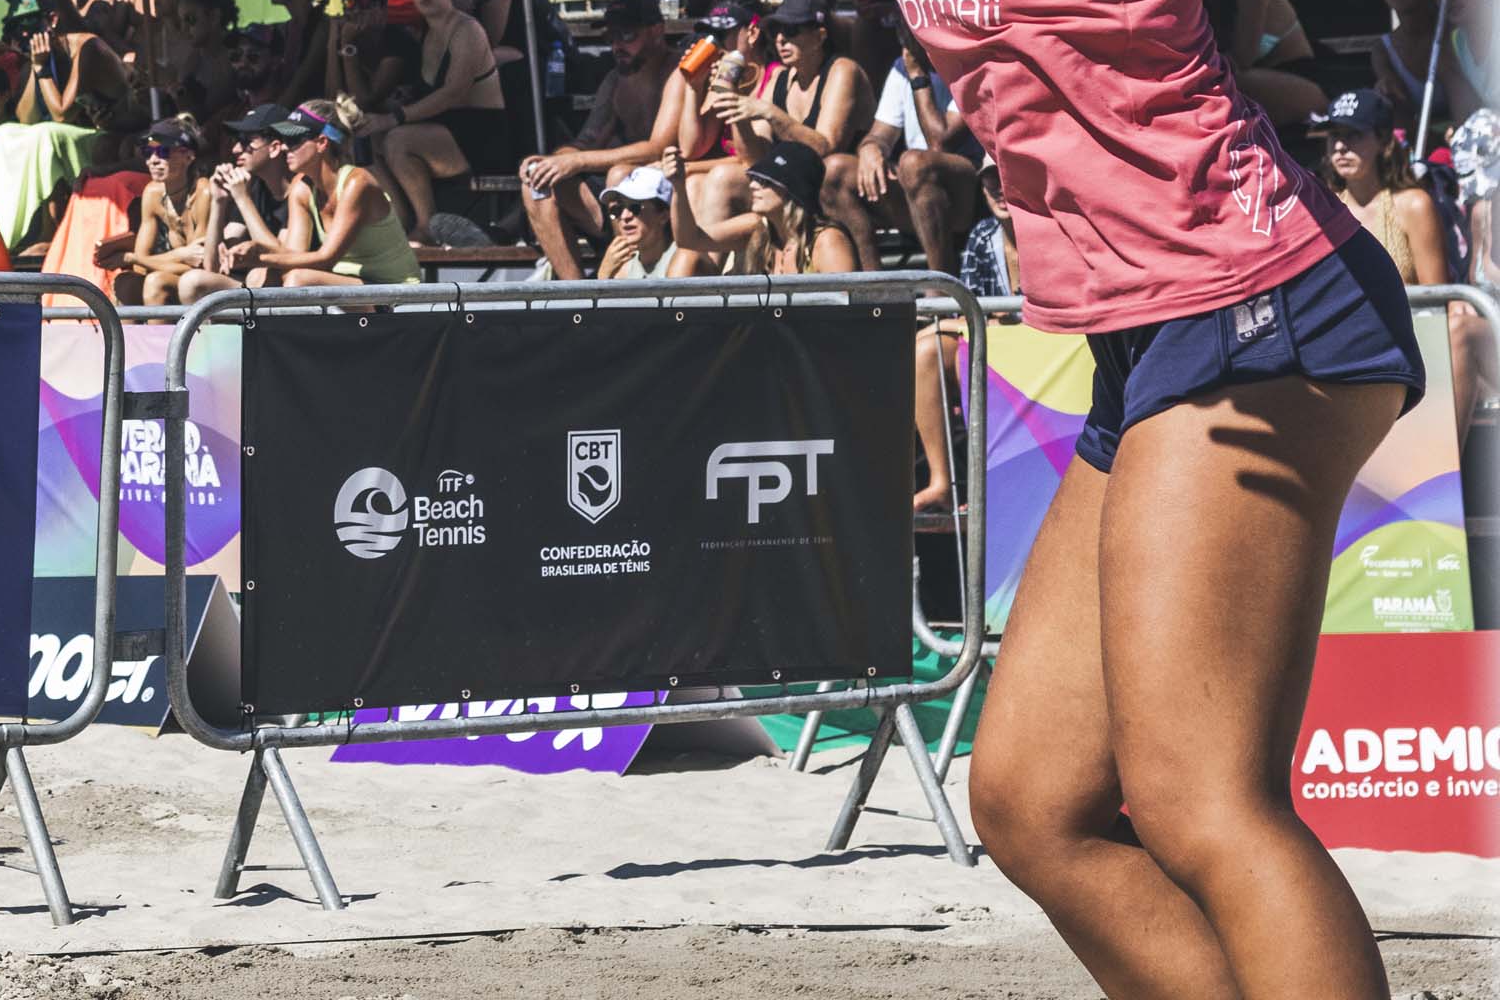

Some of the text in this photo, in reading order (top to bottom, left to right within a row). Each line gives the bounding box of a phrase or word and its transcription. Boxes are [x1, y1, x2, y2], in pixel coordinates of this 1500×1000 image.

[574, 441, 614, 460] CBT
[439, 477, 463, 492] ITF
[706, 439, 835, 524] FPT
[413, 494, 484, 521] Beach
[412, 520, 486, 547] Tennis
[540, 539, 650, 561] CONFEDERAÇÃO
[541, 558, 651, 577] BRASILEIRA DE TÊNIS
[1302, 774, 1500, 799] consórcio e inve
